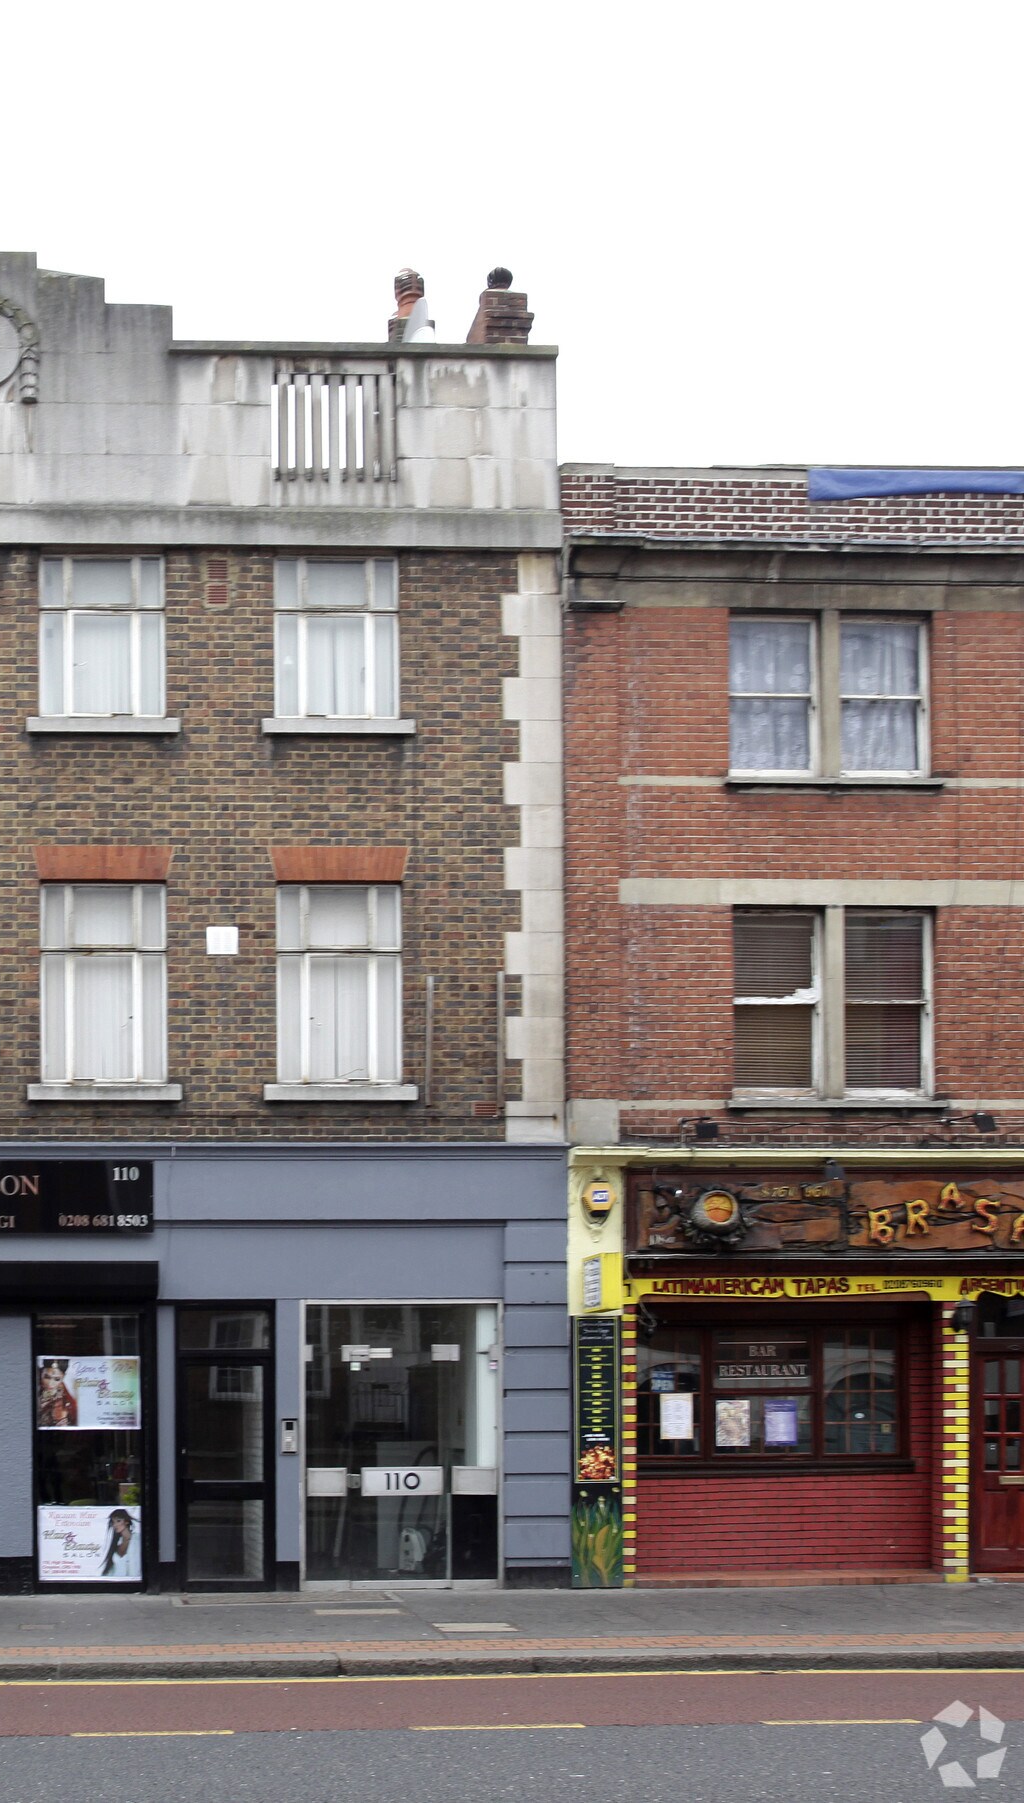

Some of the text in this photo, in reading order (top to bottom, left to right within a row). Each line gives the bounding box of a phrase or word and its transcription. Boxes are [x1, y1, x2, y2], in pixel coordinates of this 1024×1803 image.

[113, 1167, 140, 1181] 110
[59, 1214, 149, 1227] 0208 681 8503
[792, 1277, 850, 1295] TAPAS
[749, 1345, 776, 1357] BAR
[718, 1364, 807, 1377] RESTAURANT
[384, 1472, 421, 1490] 110
